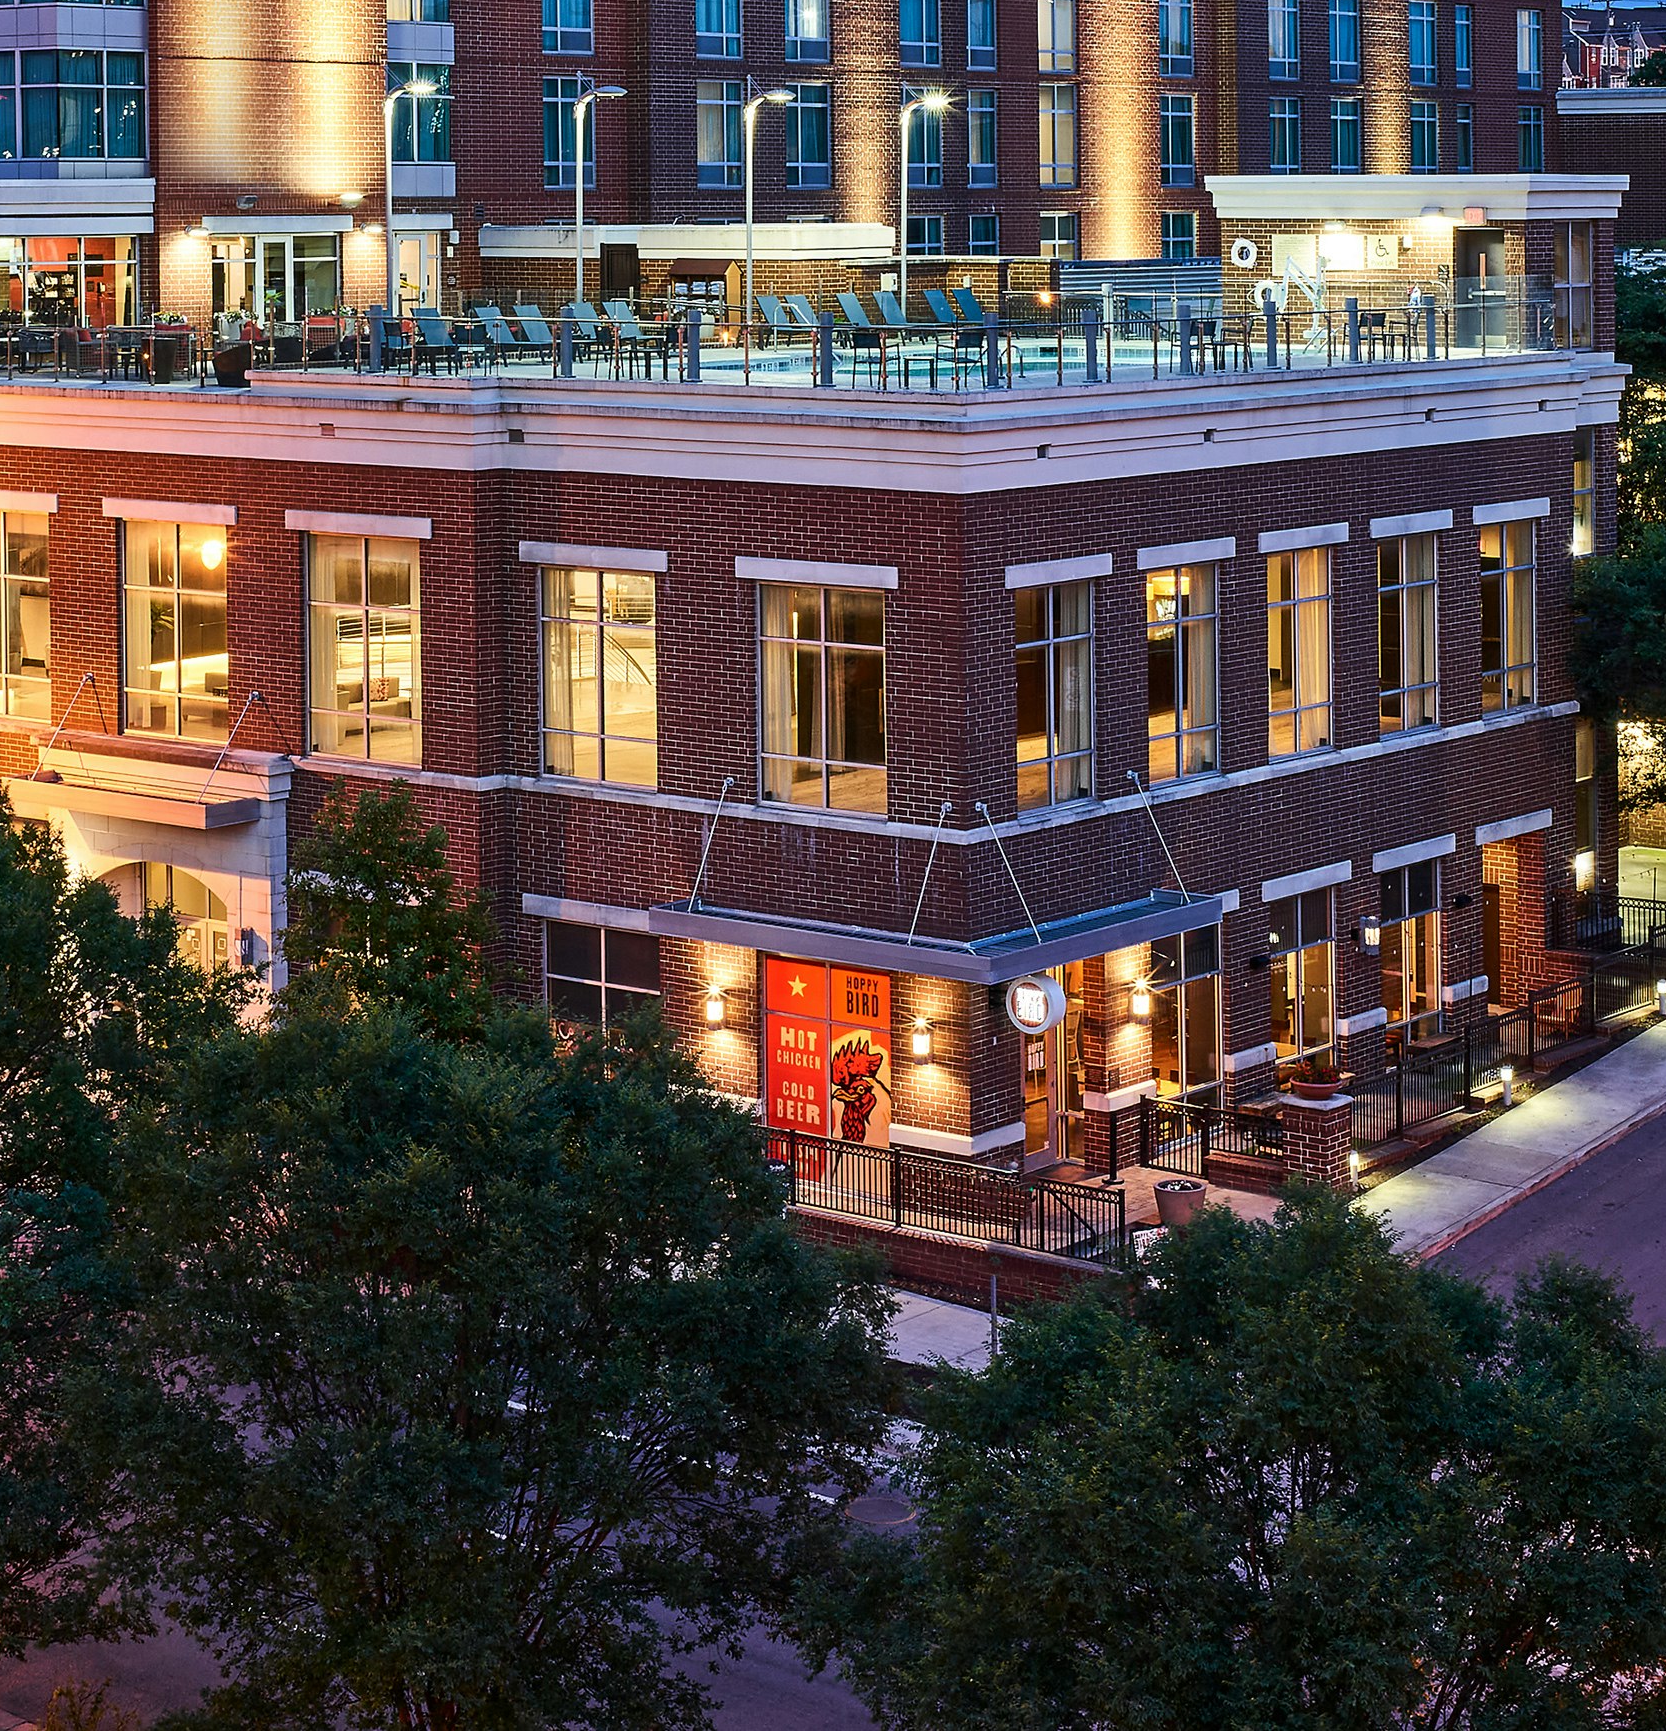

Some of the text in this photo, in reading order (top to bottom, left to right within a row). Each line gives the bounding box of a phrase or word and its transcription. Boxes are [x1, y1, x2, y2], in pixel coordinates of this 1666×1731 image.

[846, 975, 879, 994] HOPPY
[846, 990, 879, 1018] BIRD
[780, 1026, 817, 1052] HOT
[776, 1050, 821, 1070] CHICKEN
[782, 1080, 815, 1100] COLD
[776, 1098, 821, 1125] BEER
